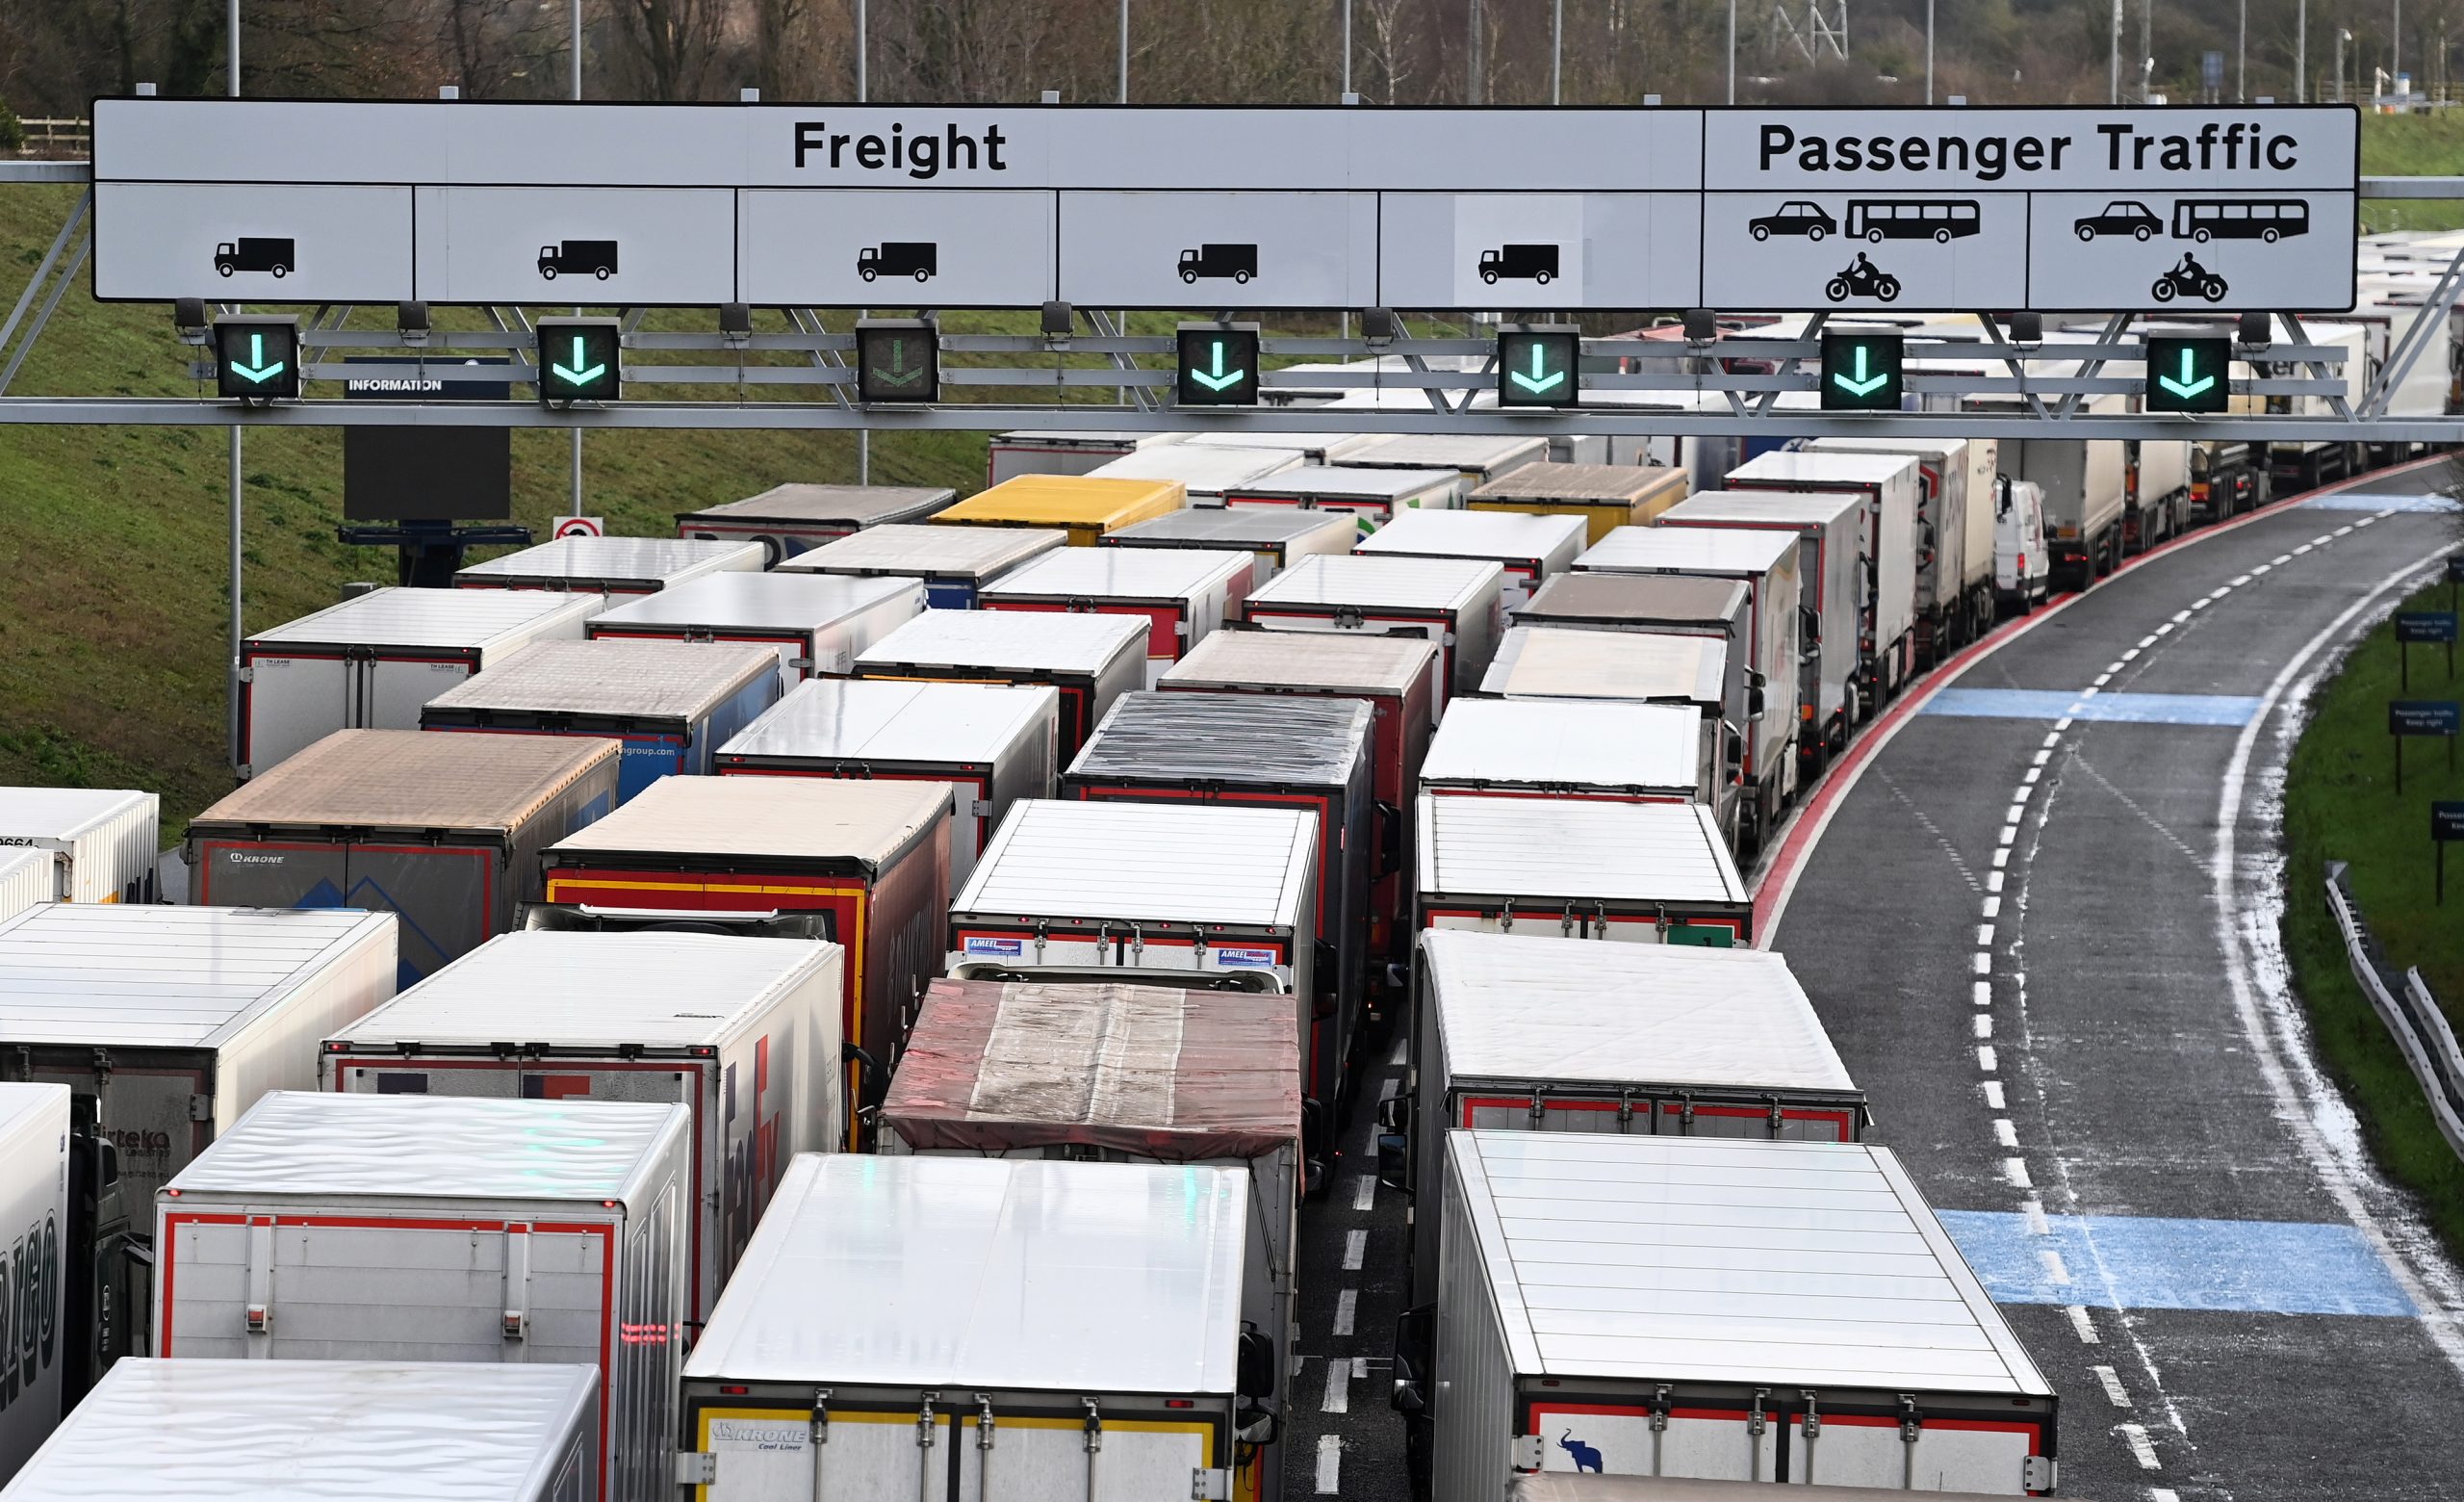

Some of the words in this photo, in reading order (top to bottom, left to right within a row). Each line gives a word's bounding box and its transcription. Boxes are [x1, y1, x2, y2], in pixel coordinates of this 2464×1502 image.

[795, 122, 1007, 179] Freight
[1758, 124, 2071, 181] Passenger
[2097, 123, 2298, 171] Traffic
[348, 380, 442, 391] INFORMATION
[244, 855, 284, 864] KRONE
[734, 1429, 807, 1443] KRONE
